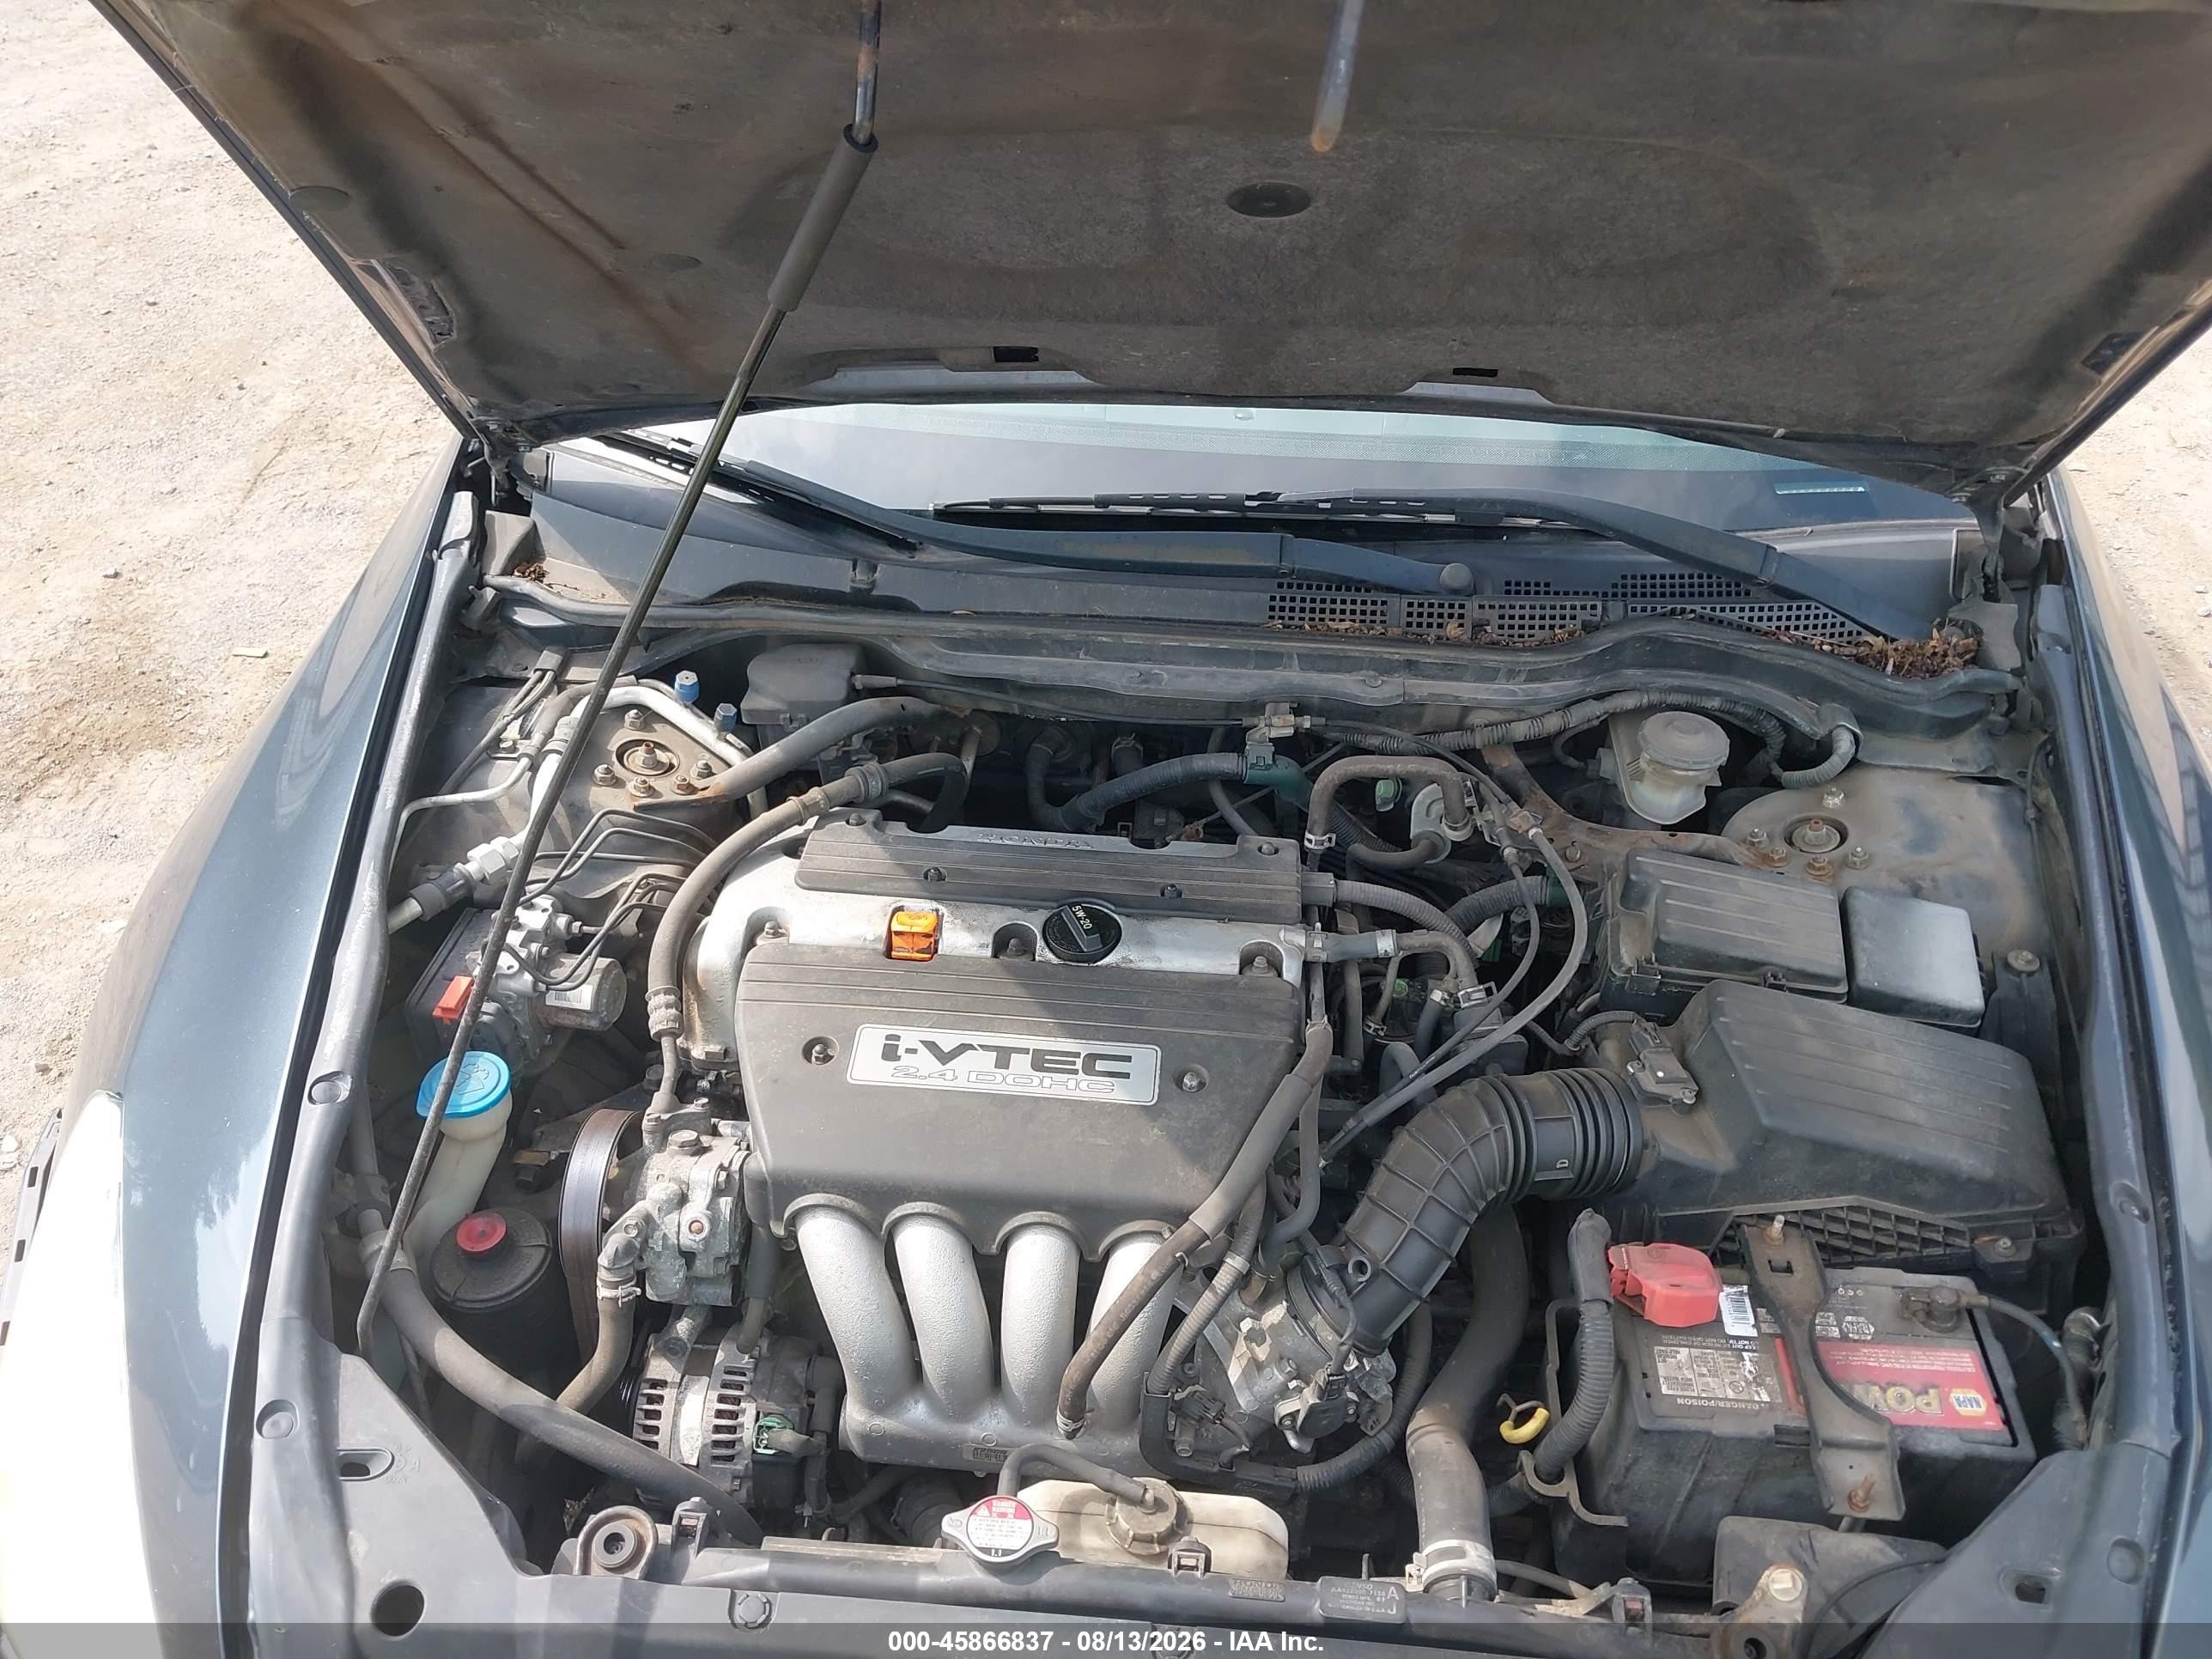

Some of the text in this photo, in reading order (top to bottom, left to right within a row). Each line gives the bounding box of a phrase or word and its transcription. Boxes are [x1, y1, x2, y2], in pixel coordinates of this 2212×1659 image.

[1072, 905, 1093, 930] 5W-20
[881, 1033, 1133, 1079] i-VTEC
[891, 1065, 1115, 1093] 2.4 DOHC
[1953, 1395, 1982, 1409] NAPA
[1387, 1586, 1400, 1601] A
